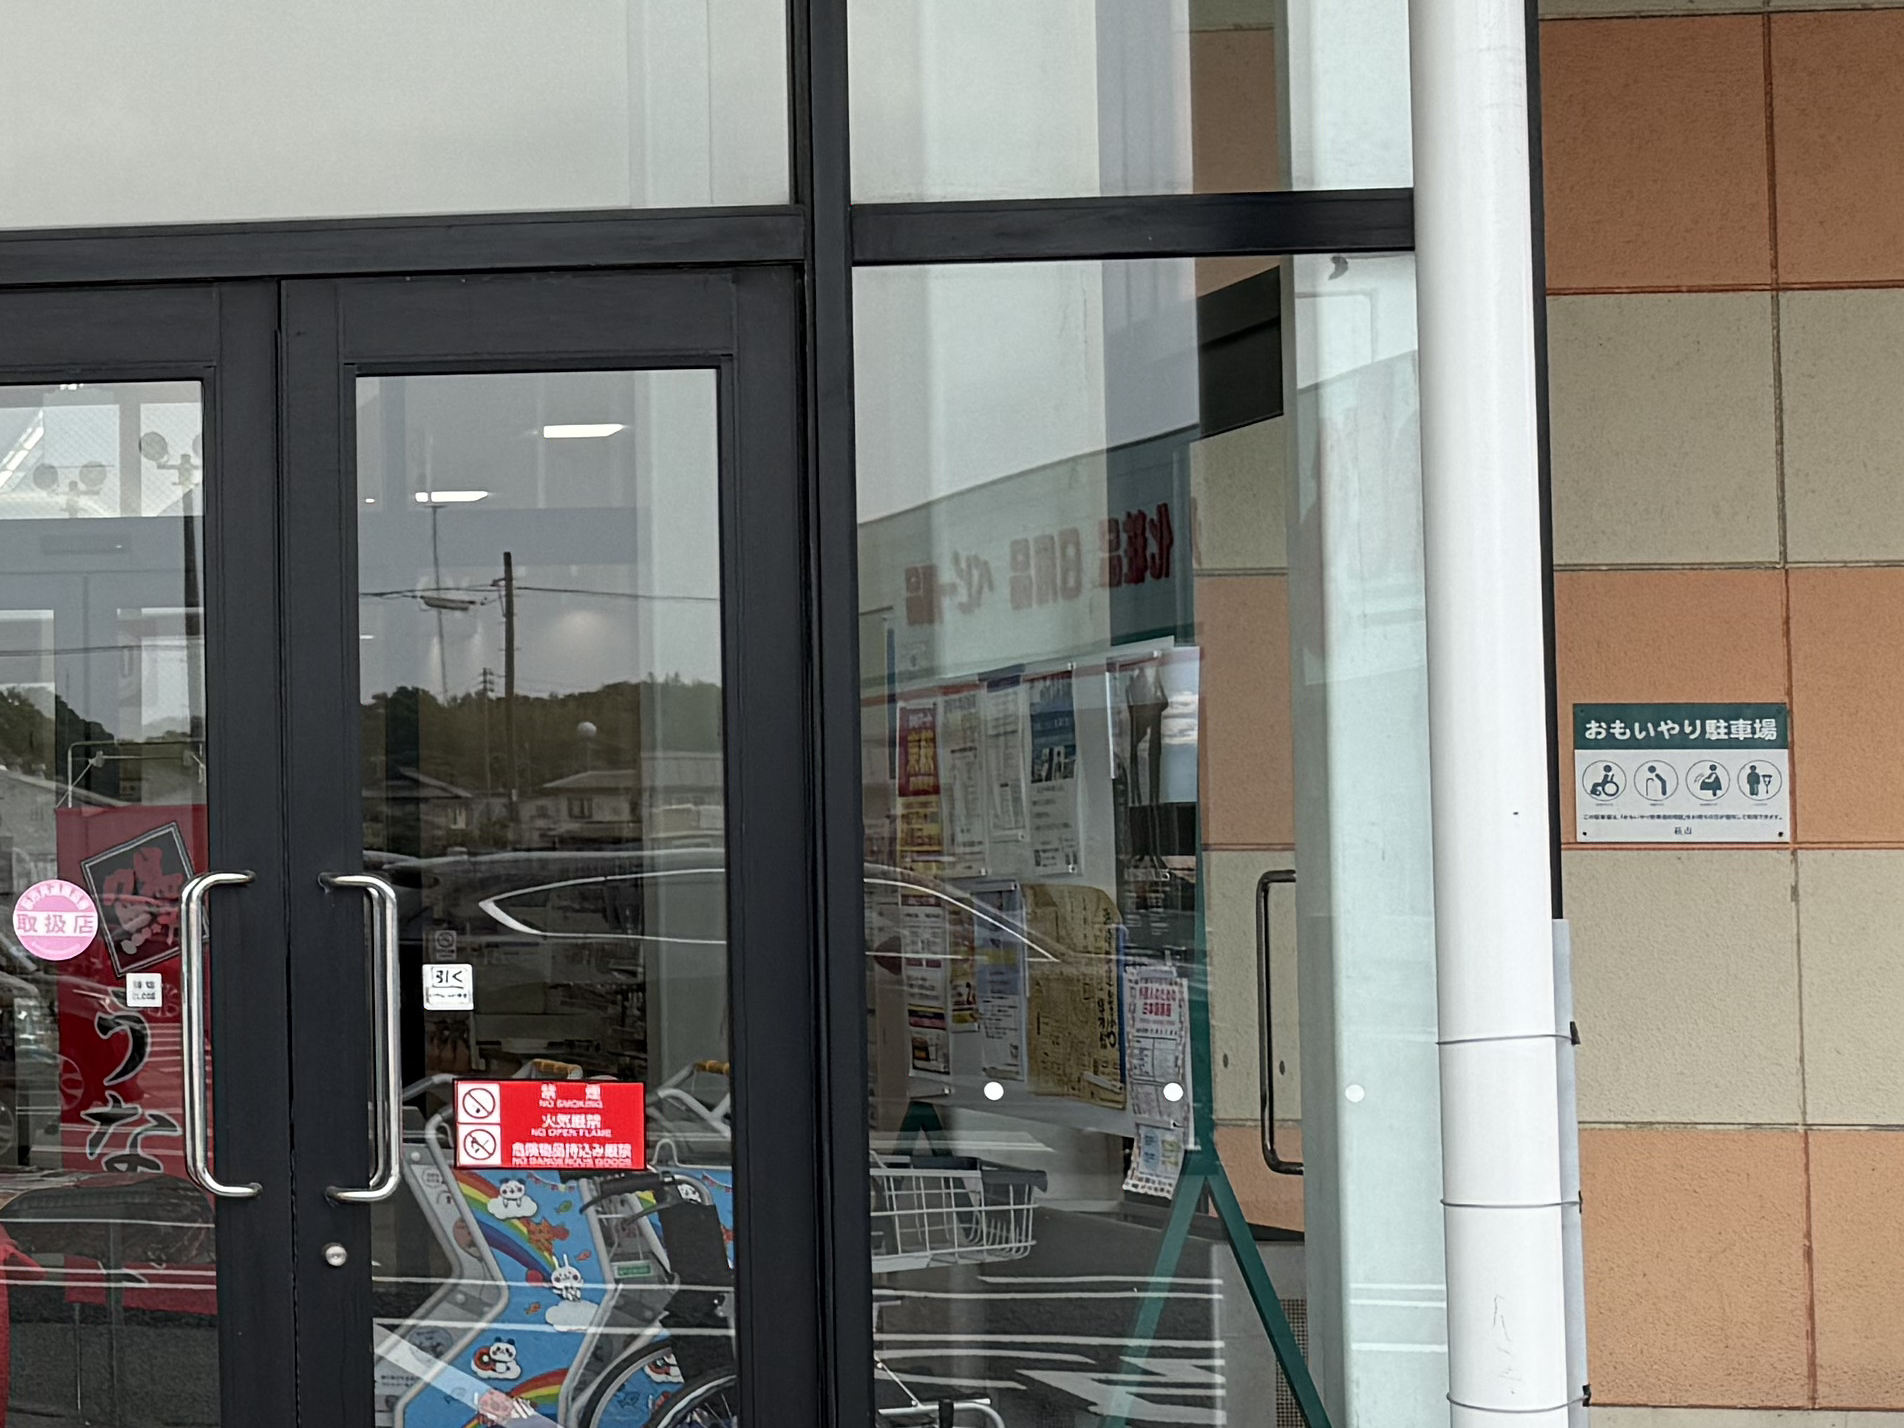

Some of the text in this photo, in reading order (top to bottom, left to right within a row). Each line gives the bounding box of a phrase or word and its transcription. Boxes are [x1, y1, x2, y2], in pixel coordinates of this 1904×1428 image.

[1585, 718, 1778, 741] おもいやり駐車場
[17, 913, 94, 934] 取扱店
